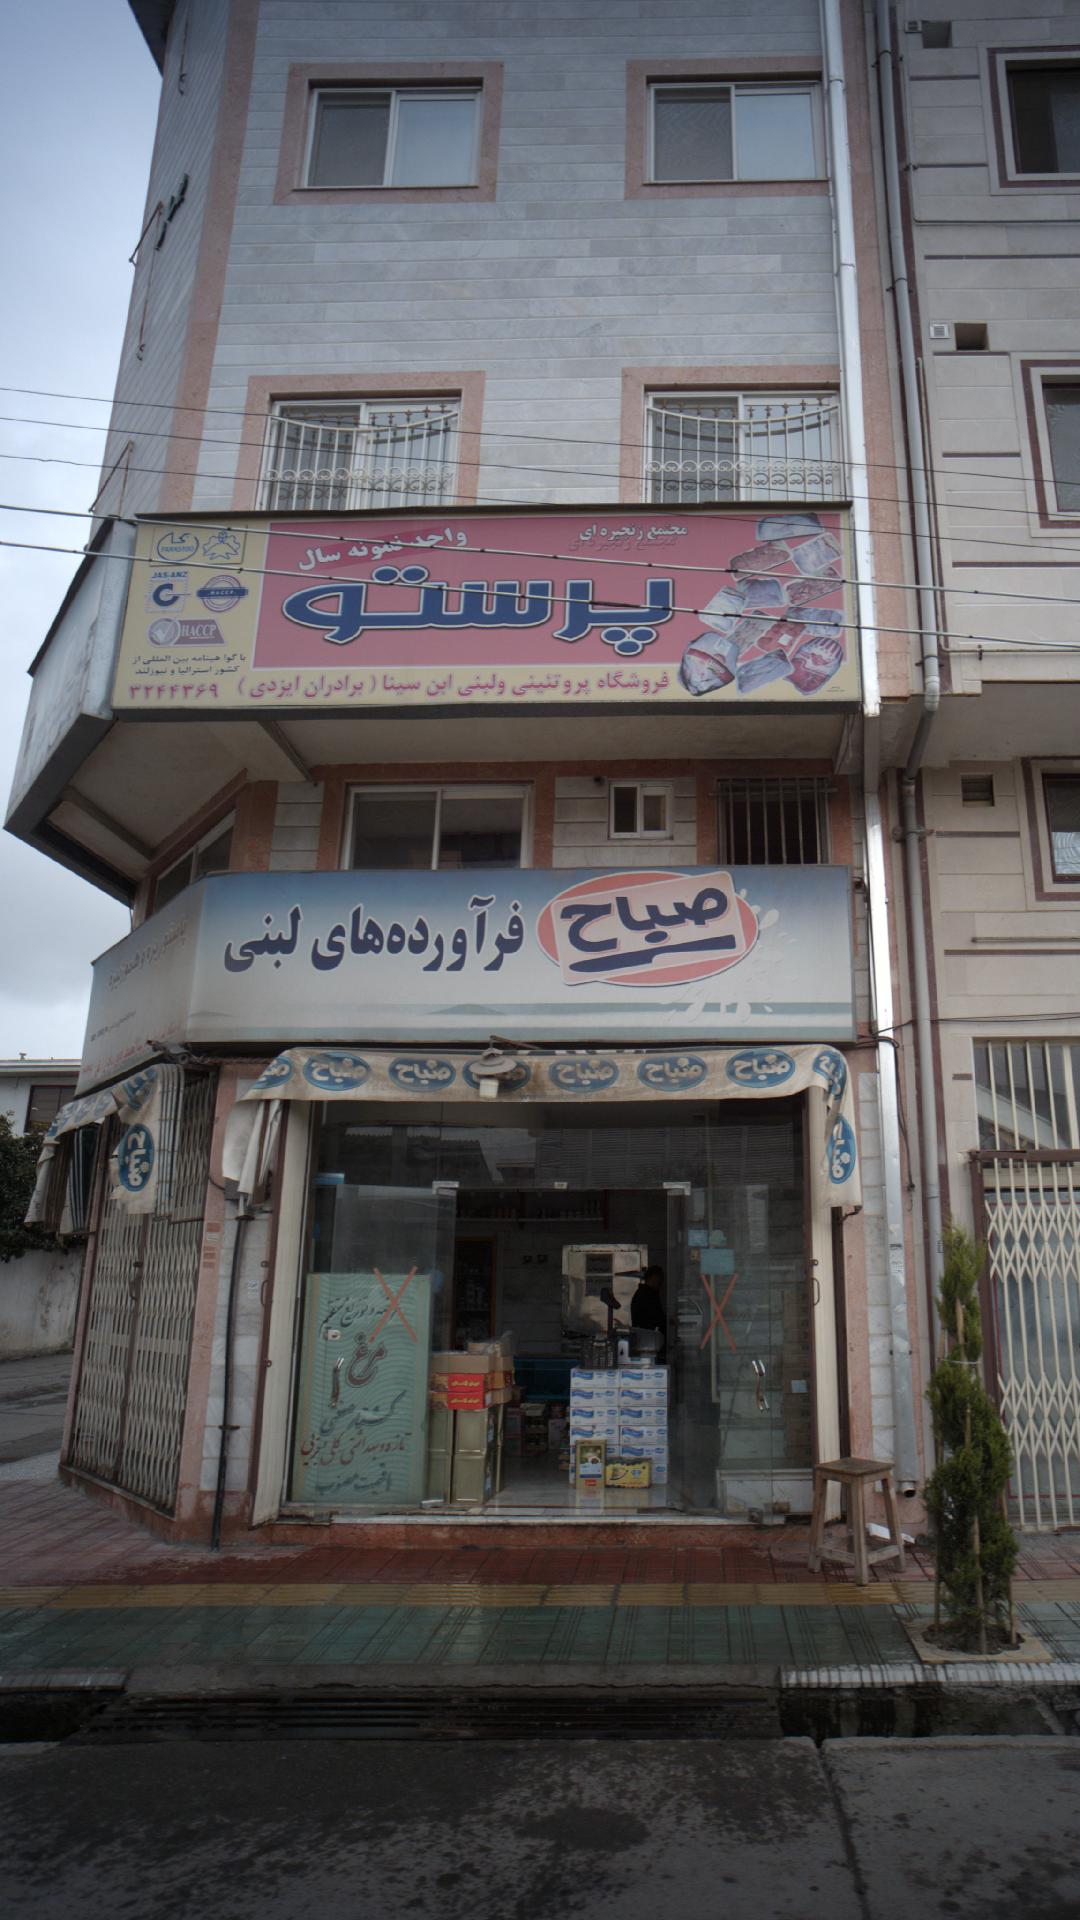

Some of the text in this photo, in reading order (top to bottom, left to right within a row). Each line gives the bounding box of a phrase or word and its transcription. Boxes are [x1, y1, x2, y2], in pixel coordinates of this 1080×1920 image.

[299, 548, 341, 571] سال
[180, 624, 218, 638] HACCP
[281, 563, 675, 656] پرستو
[597, 671, 671, 695] فروشگاه
[223, 903, 303, 973] لبنی
[560, 887, 729, 954] صباح
[346, 1332, 387, 1388] مرغ
